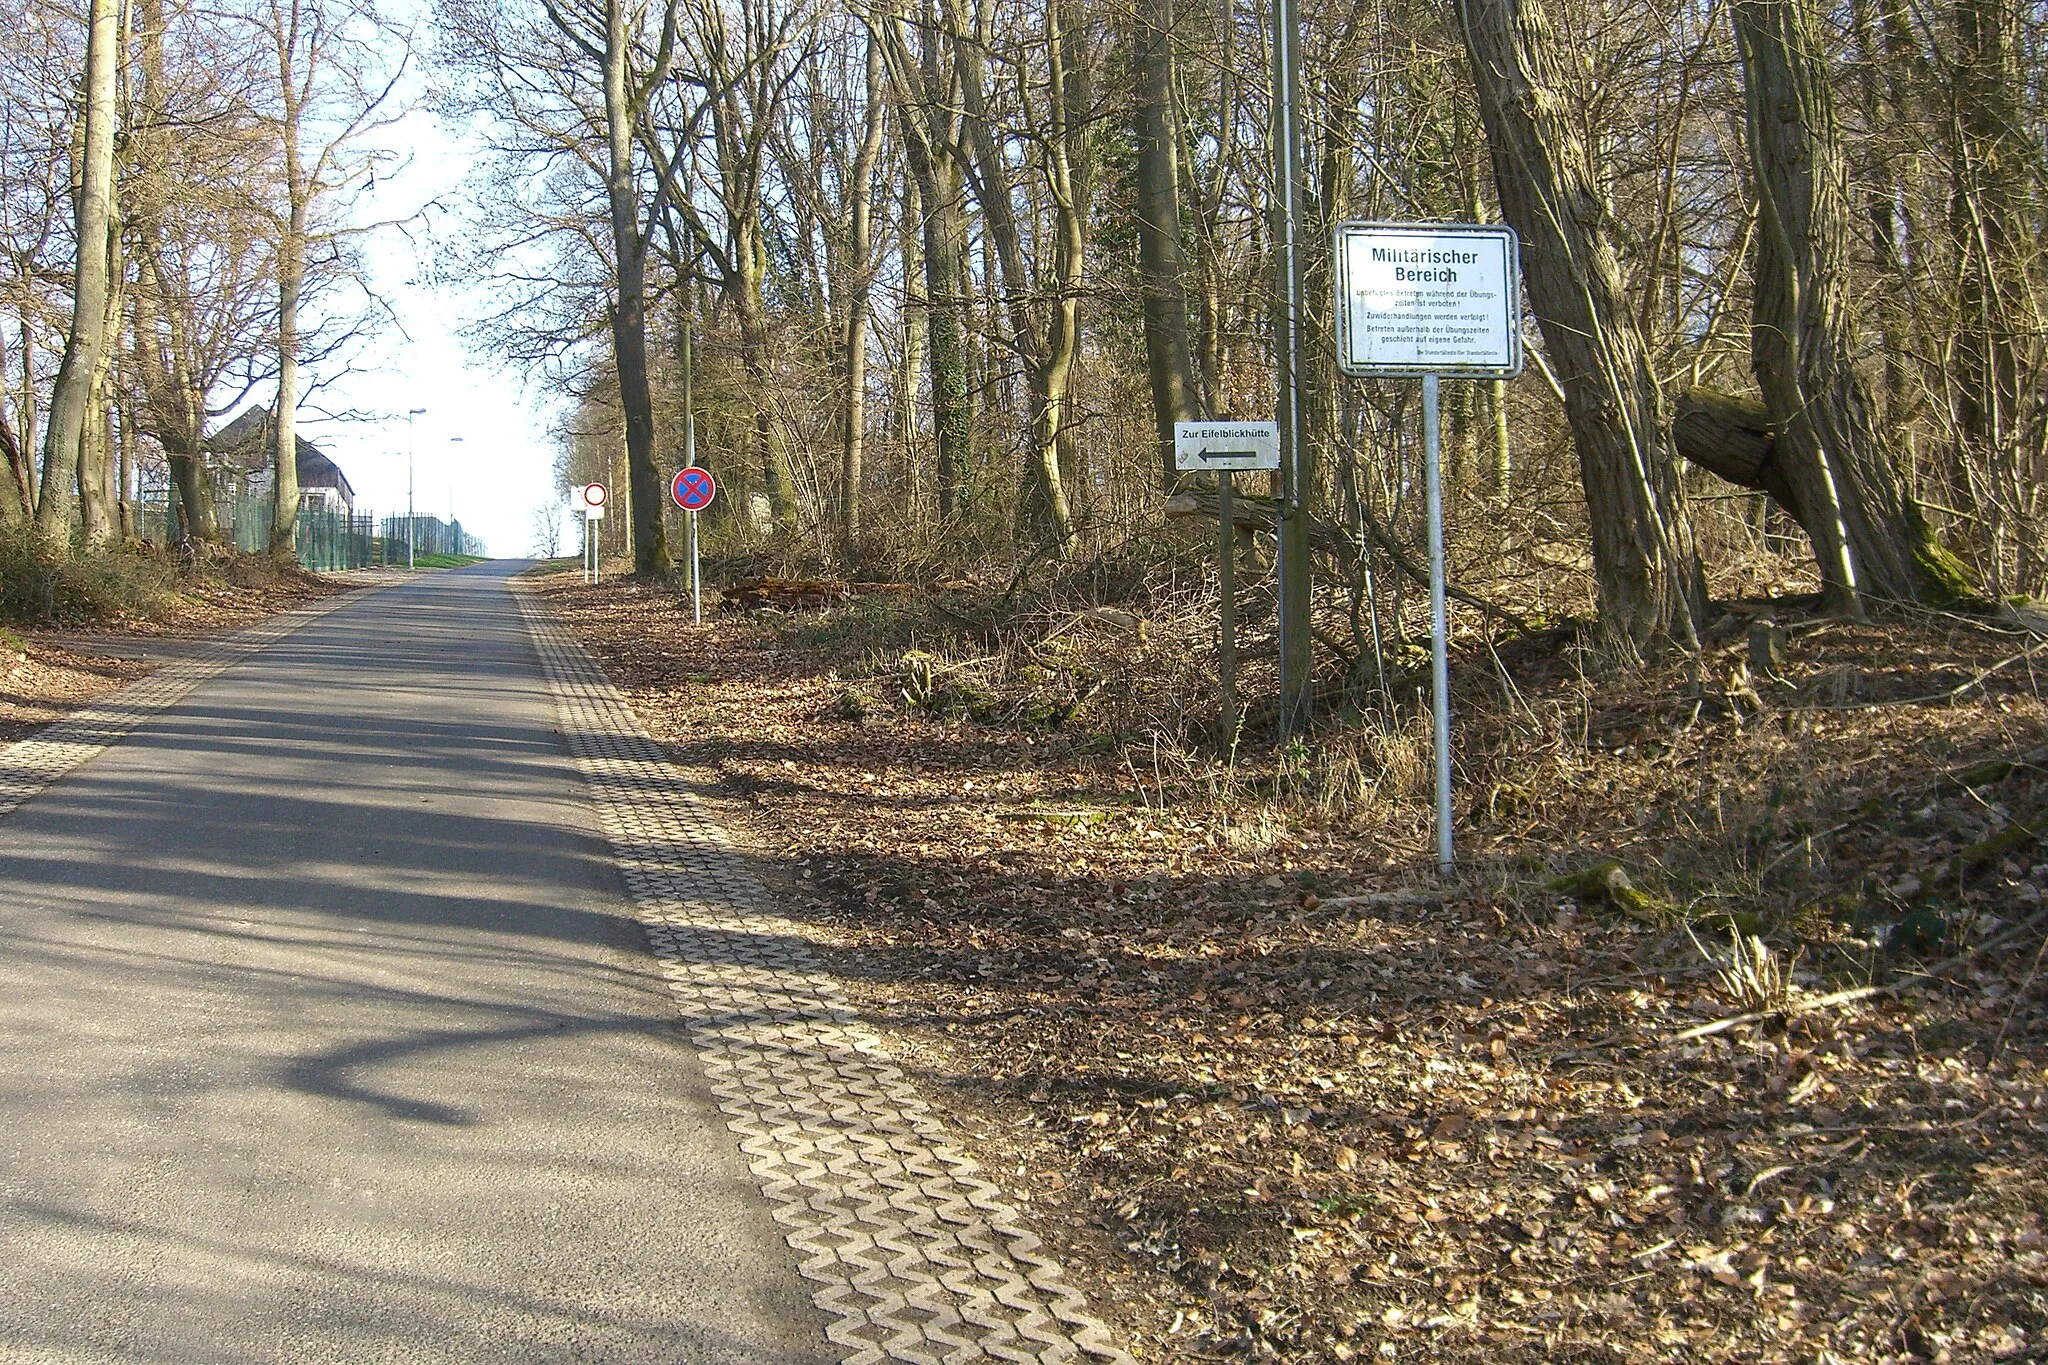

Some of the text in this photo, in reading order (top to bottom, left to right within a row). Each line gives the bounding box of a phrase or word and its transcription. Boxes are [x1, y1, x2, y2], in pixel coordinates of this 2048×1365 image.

[1372, 247, 1478, 264] Militärischer
[1395, 267, 1457, 282] Bereich
[1396, 290, 1424, 298] Betreten
[1426, 290, 1454, 298] während
[1469, 289, 1497, 300] Übungs-
[1366, 311, 1432, 321] Zuwiderhandlungen
[1397, 325, 1430, 333] außerhalb
[1445, 325, 1490, 335] Übungszeiten
[1381, 336, 1414, 344] geschieht
[1428, 336, 1451, 344] eigene
[1182, 429, 1270, 438] Zur Eifelblickhütte
